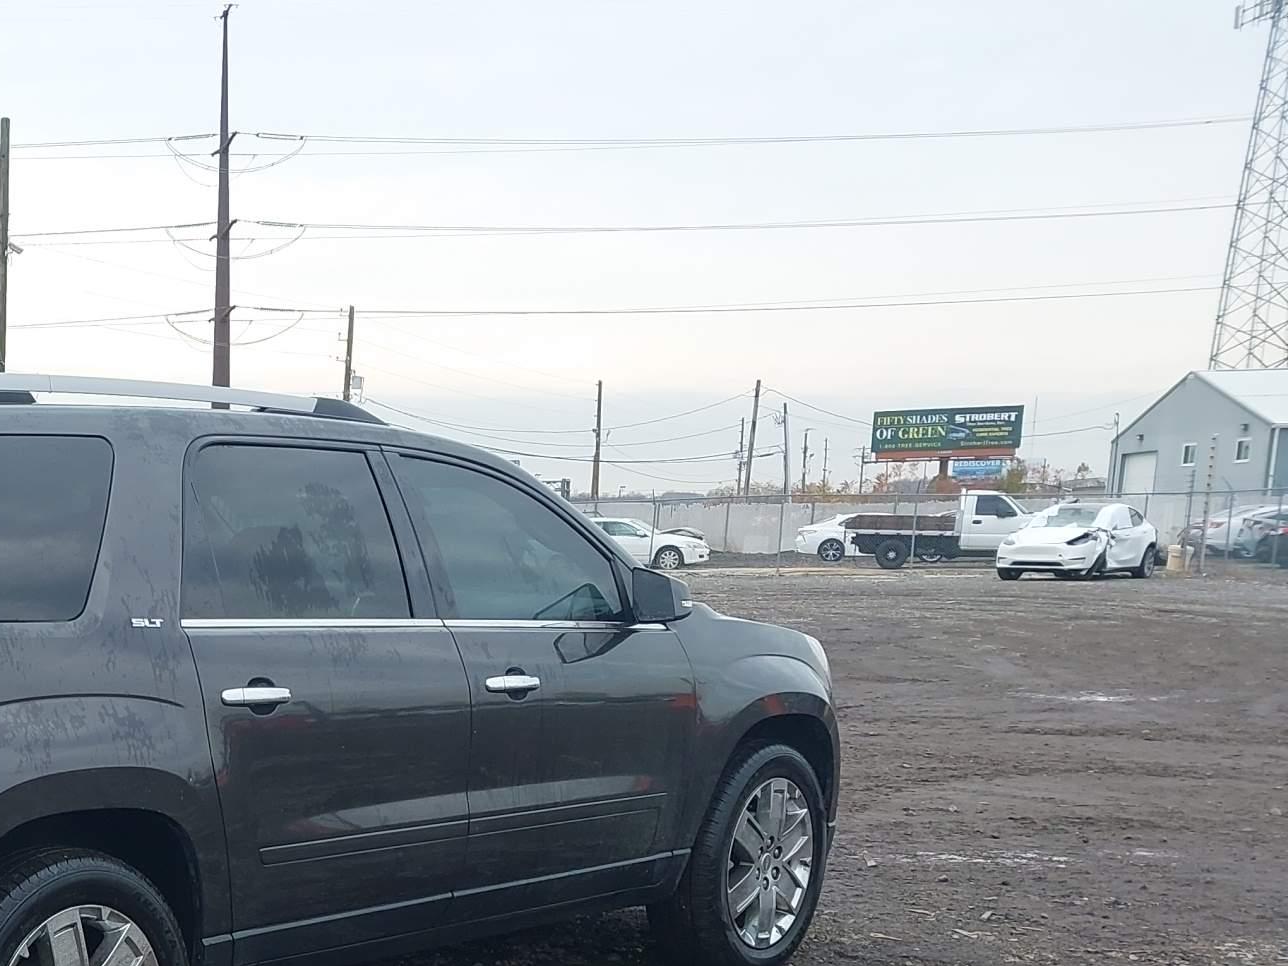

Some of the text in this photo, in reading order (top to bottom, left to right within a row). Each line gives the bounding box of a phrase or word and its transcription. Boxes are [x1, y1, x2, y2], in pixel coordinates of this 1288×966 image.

[877, 413, 949, 426] FIFTY SHADES
[955, 412, 1019, 424] STROBERT
[876, 425, 947, 440] OF GREEN
[131, 617, 164, 628] SLT
